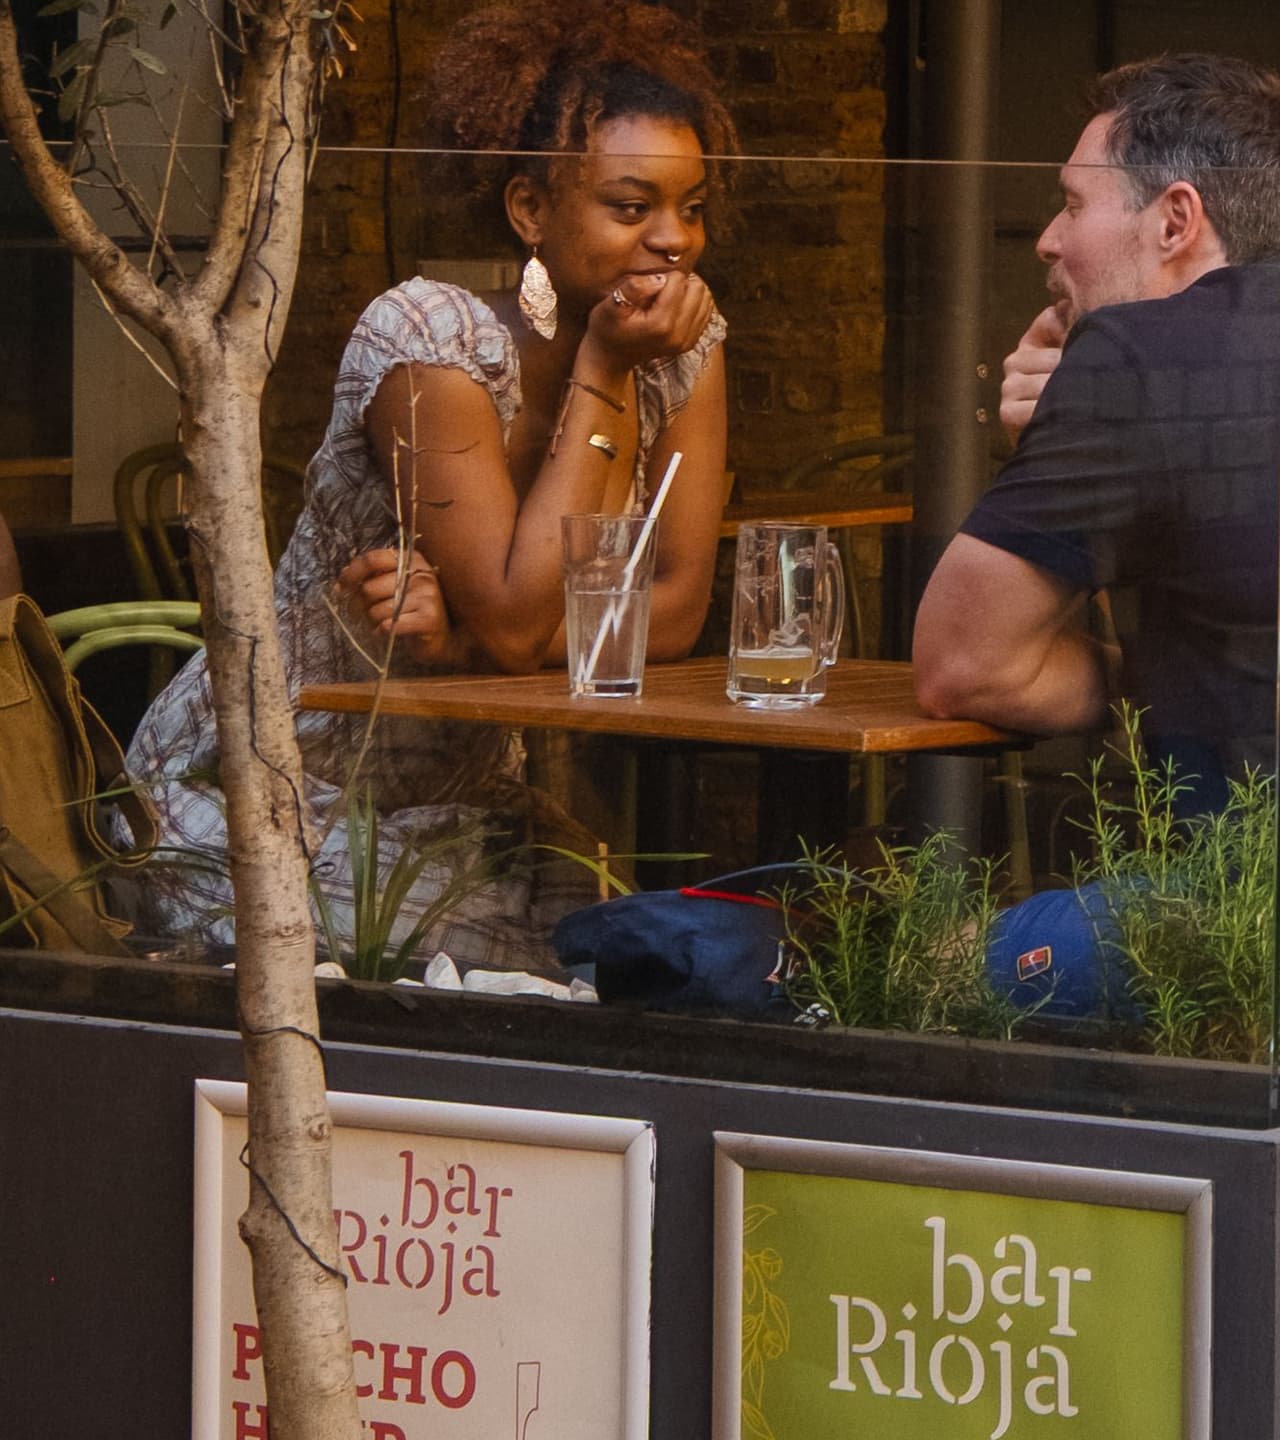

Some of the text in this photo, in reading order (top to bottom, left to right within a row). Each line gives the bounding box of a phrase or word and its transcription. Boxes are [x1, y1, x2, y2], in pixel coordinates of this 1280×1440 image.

[399, 1150, 513, 1238] bar
[332, 1209, 501, 1316] Rioja
[924, 1216, 1092, 1337] bar
[232, 1323, 476, 1409] PCHO
[828, 1293, 1079, 1440] Rioja
